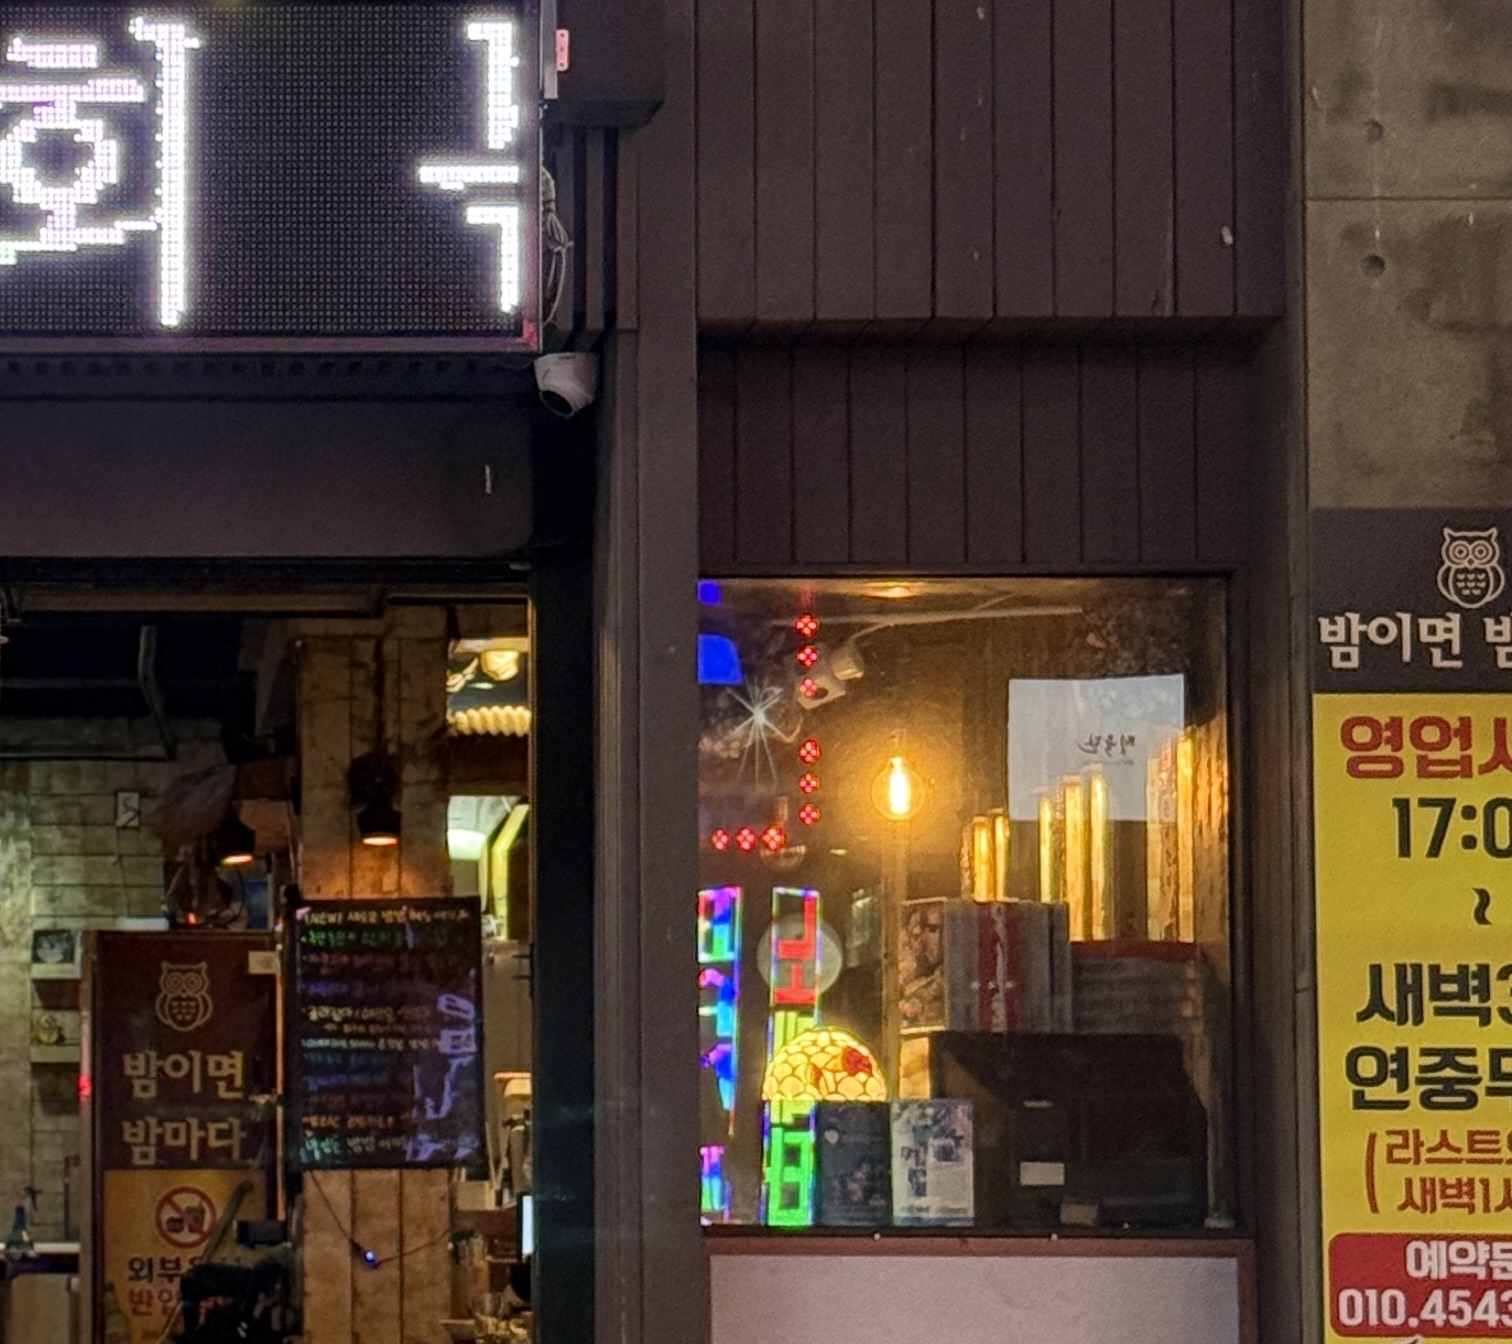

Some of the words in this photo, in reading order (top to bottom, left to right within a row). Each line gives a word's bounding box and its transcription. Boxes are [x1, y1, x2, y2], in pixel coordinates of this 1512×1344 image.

[1317, 611, 1463, 670] 밤이면
[122, 1050, 244, 1100] 밤이면
[122, 1116, 248, 1166] 밤마다
